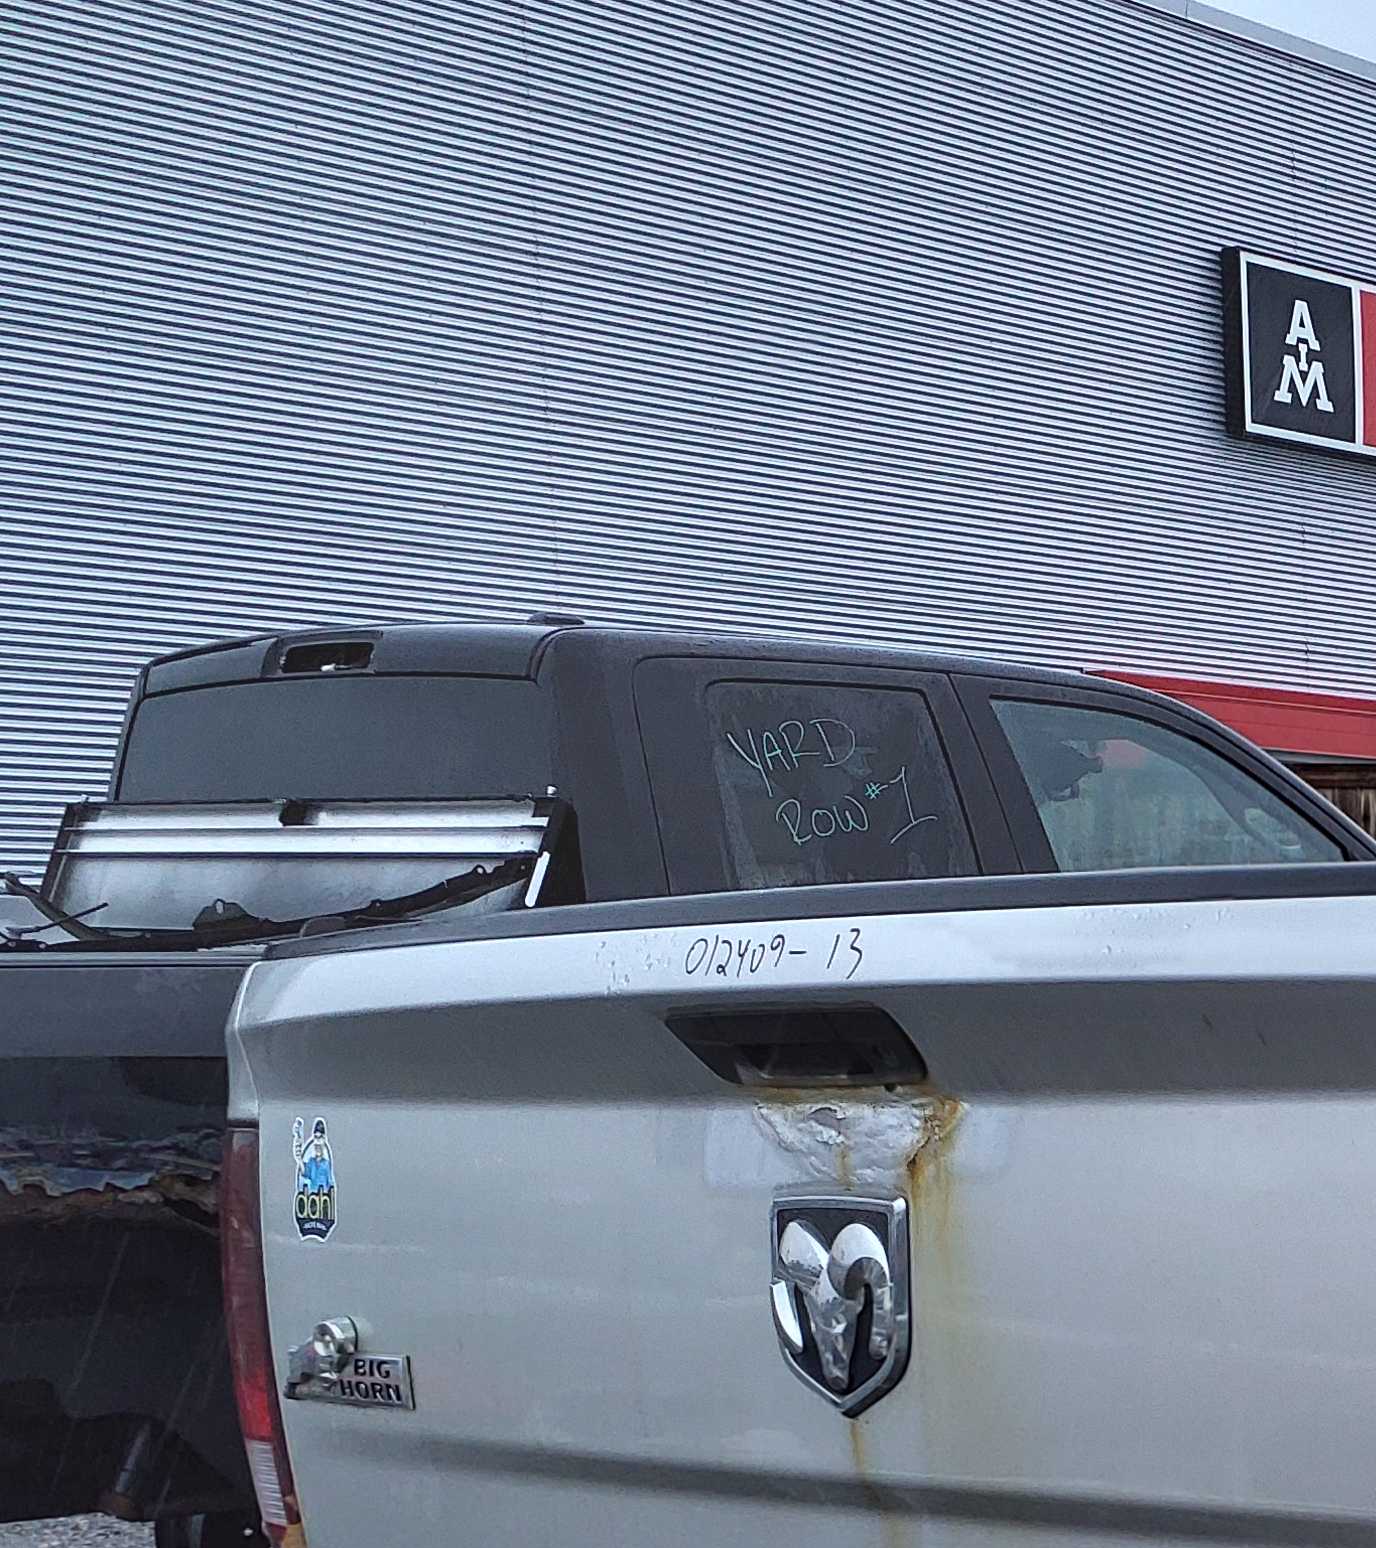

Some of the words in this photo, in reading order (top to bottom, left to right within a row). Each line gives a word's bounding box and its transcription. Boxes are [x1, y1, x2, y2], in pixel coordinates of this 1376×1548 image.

[726, 718, 856, 797] YARD
[775, 794, 869, 846] ROW
[295, 1183, 336, 1220] dahl
[353, 1358, 391, 1379] BIG
[338, 1379, 403, 1402] HORN
